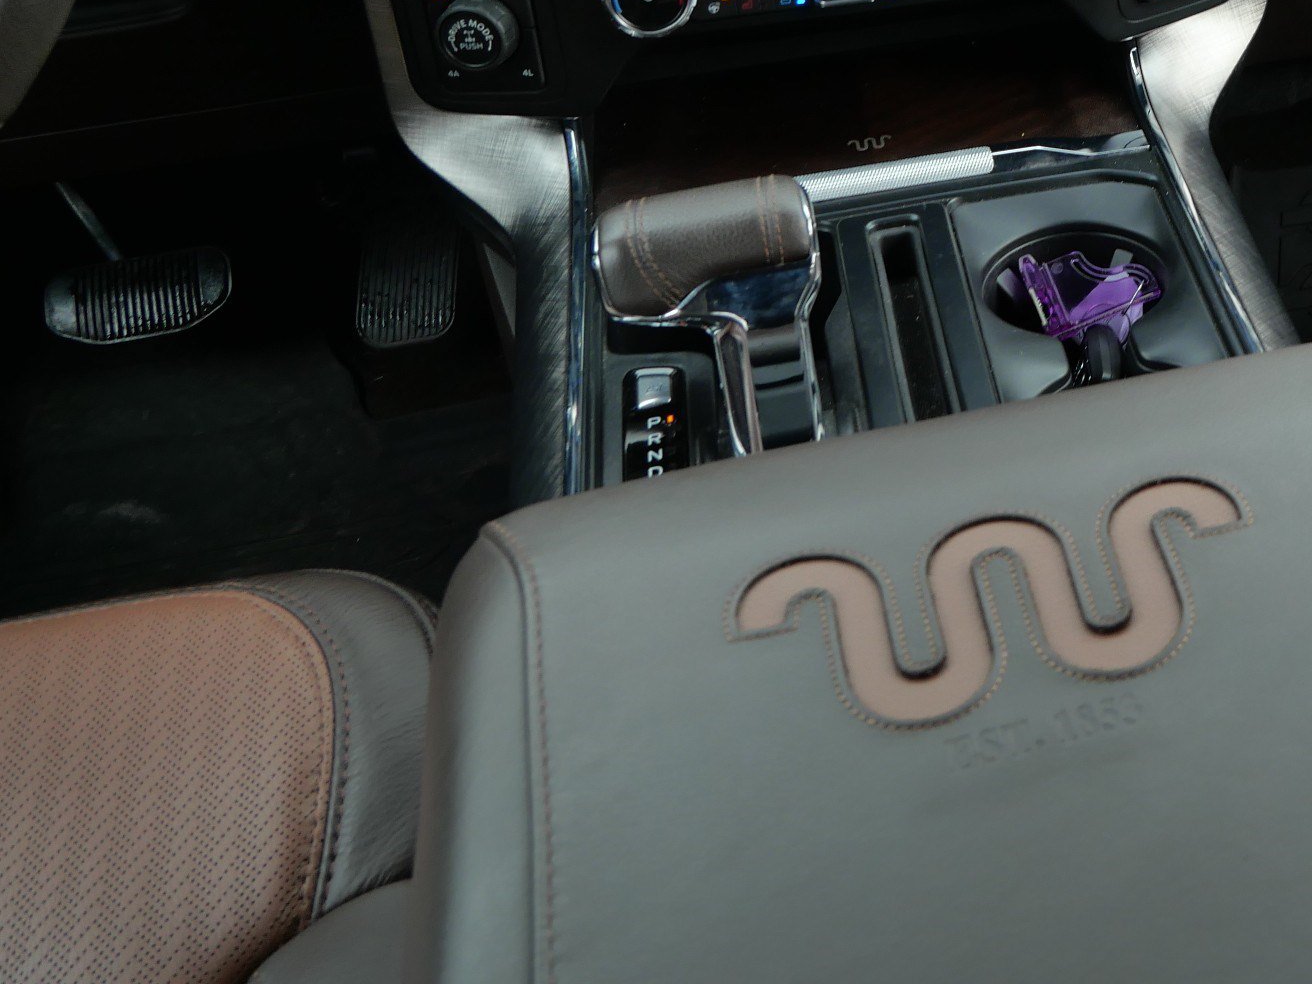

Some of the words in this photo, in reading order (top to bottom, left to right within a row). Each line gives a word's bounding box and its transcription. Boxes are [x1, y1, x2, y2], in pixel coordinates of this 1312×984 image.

[447, 18, 467, 42] DRIVE
[468, 18, 494, 42] MODE
[459, 42, 484, 51] PUSH
[448, 69, 460, 78] 4A
[522, 68, 535, 77] 4L
[646, 416, 662, 429] P
[647, 432, 662, 447] R
